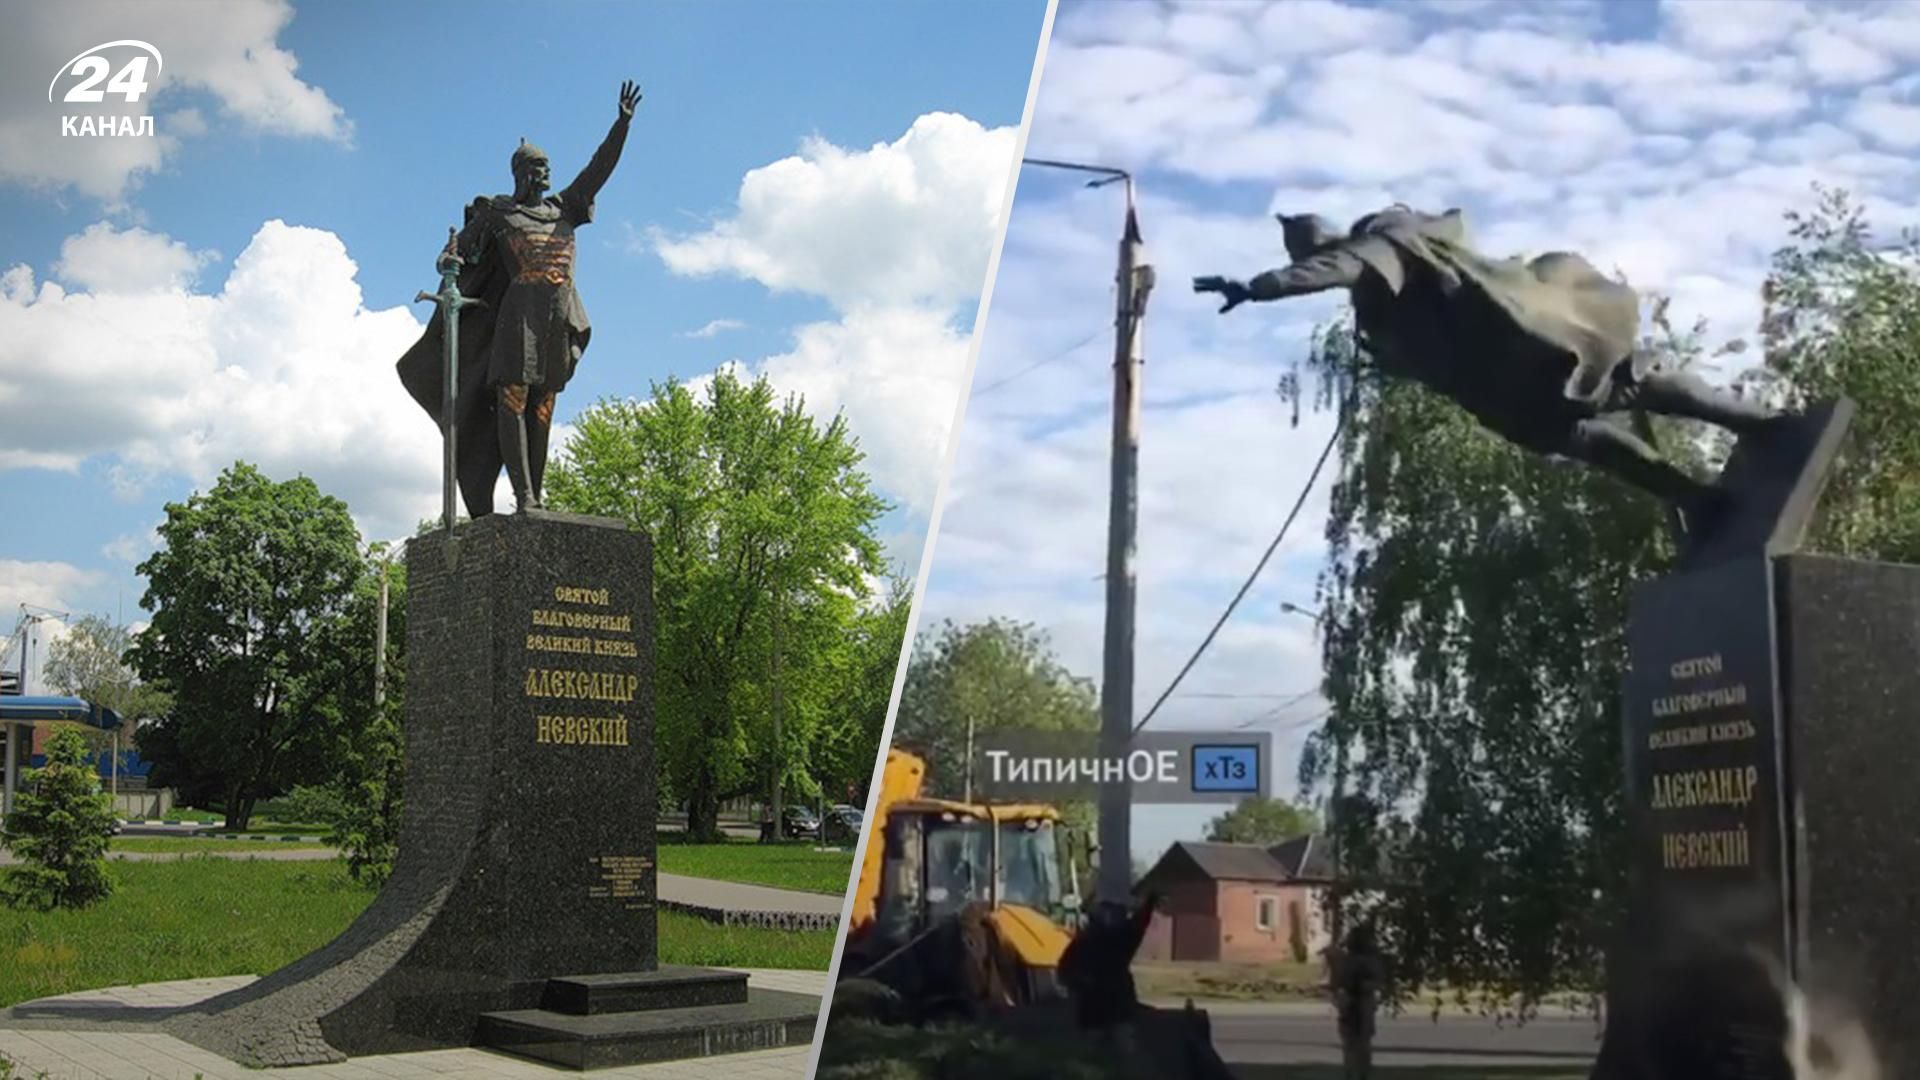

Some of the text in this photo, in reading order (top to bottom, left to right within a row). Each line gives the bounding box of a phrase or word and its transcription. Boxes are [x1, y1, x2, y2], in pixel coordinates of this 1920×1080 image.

[554, 585, 610, 606] СВЯТОЙ
[532, 609, 631, 632] БЛАГОВЕРНЫЙ
[526, 634, 637, 657] ВЕЛИКИЙ КНЯЗЬ
[525, 668, 639, 705] АЛЕКСАНДР
[536, 713, 629, 746] НЕВСКИЙ
[1651, 765, 1758, 811] АЛЕКСАНДР
[1662, 823, 1749, 870] НЕВСКИЙ
